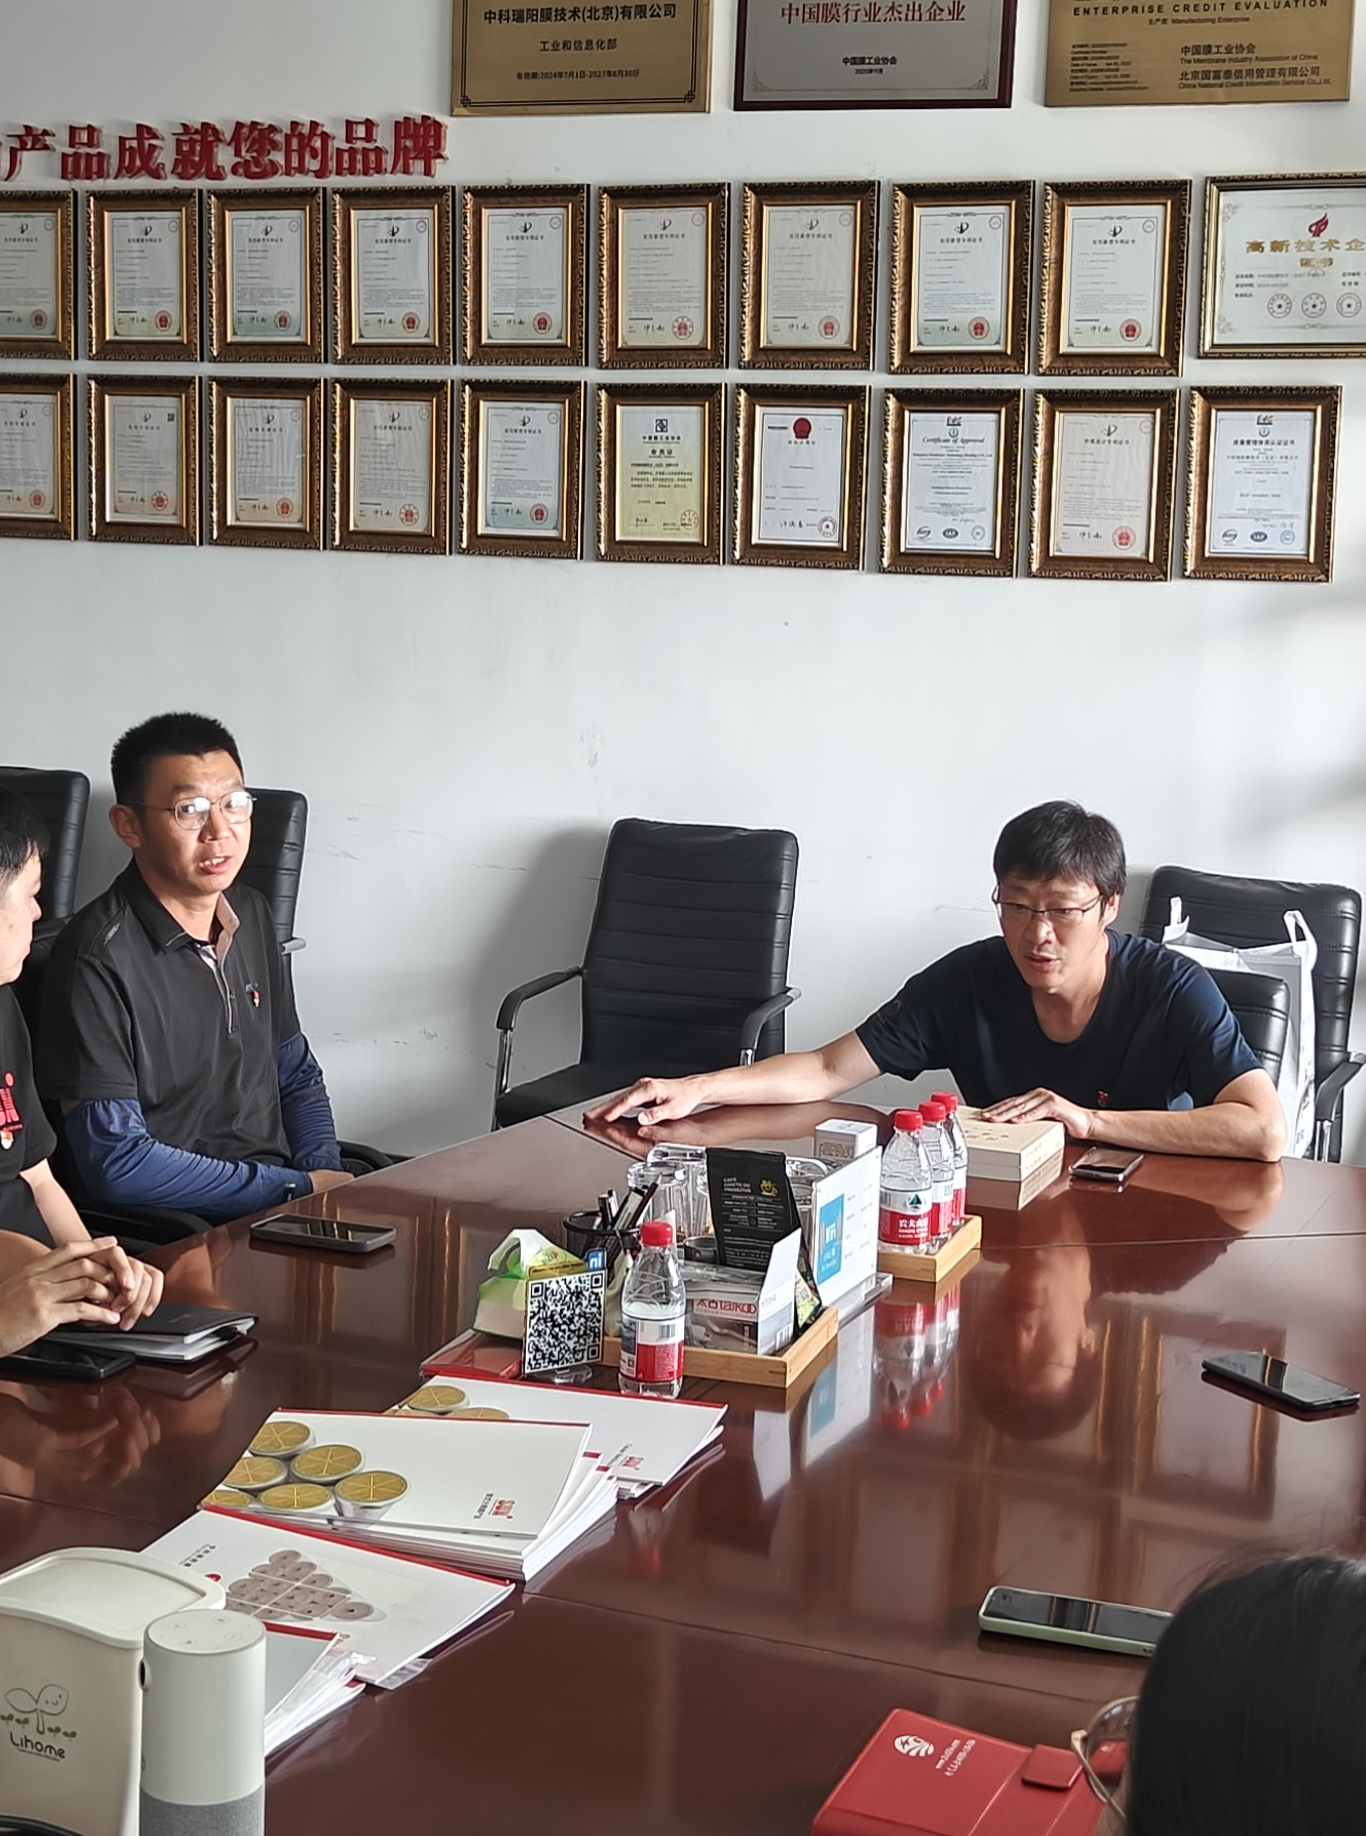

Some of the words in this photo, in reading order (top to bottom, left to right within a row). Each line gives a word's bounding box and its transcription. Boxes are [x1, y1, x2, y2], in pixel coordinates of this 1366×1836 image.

[484, 3, 677, 24] 中科瑞阳膜技术(北京)有限公司
[781, 1, 966, 25] 中国膜行业杰出企业
[1073, 5, 1165, 17] ENTERPRISE
[1173, 2, 1227, 13] CREDIT
[1234, 0, 1328, 10] EVALUATION
[539, 38, 618, 52] 工业和信息化部
[1181, 43, 1256, 56] 中国膜工业协会
[9, 1731, 66, 1759] Lihome
